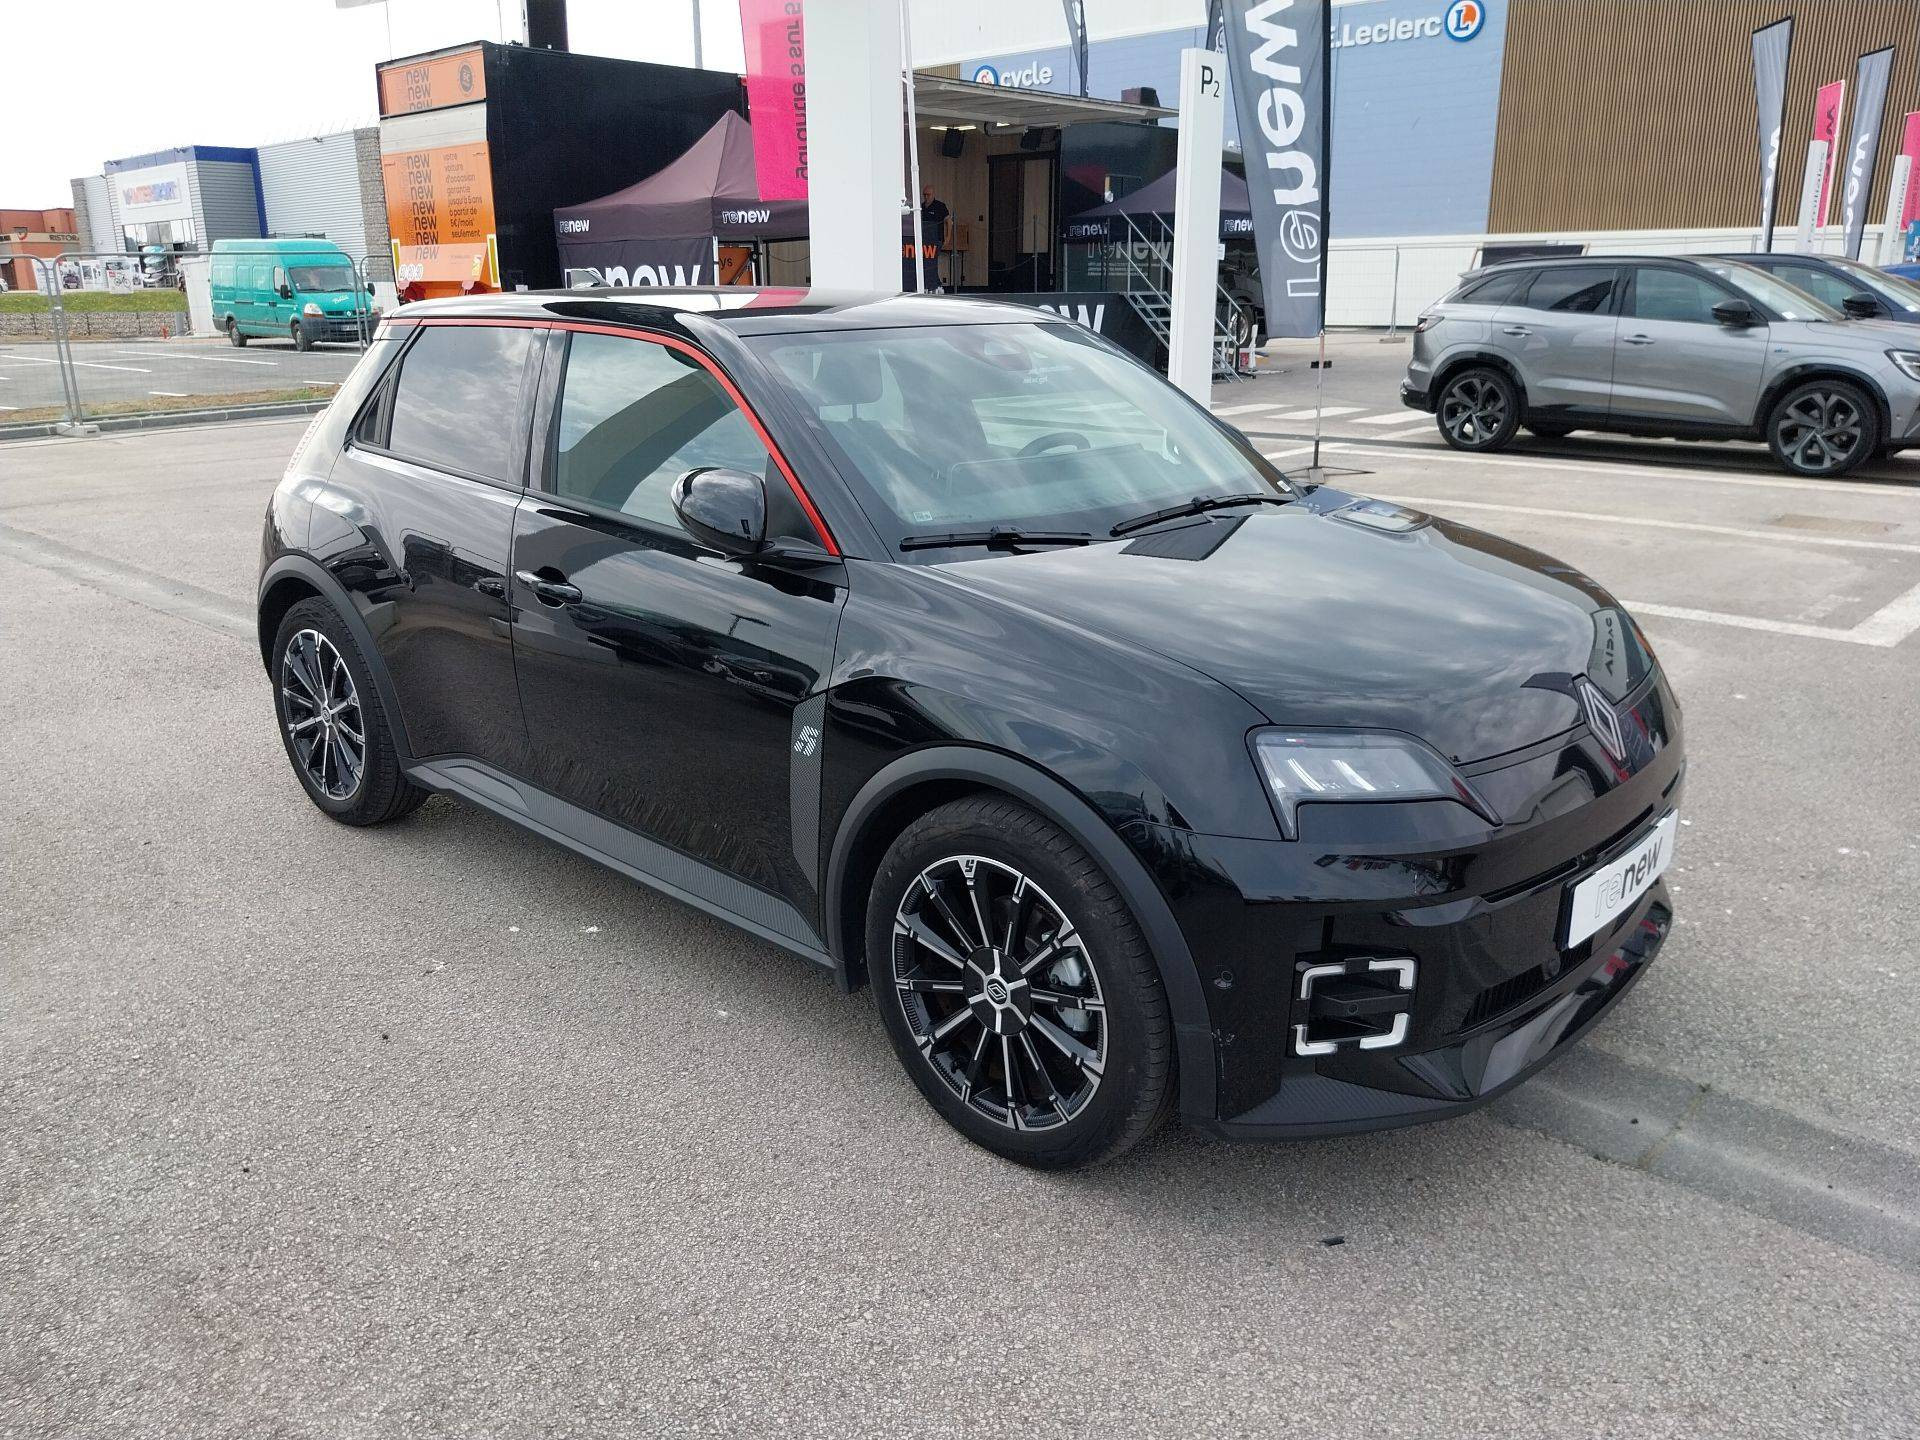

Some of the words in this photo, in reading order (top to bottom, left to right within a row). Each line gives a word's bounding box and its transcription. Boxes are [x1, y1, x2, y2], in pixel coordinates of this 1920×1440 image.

[1000, 60, 1053, 88] cycle
[560, 219, 590, 233] renew
[722, 209, 770, 225] renew
[1594, 836, 1663, 919] renew
